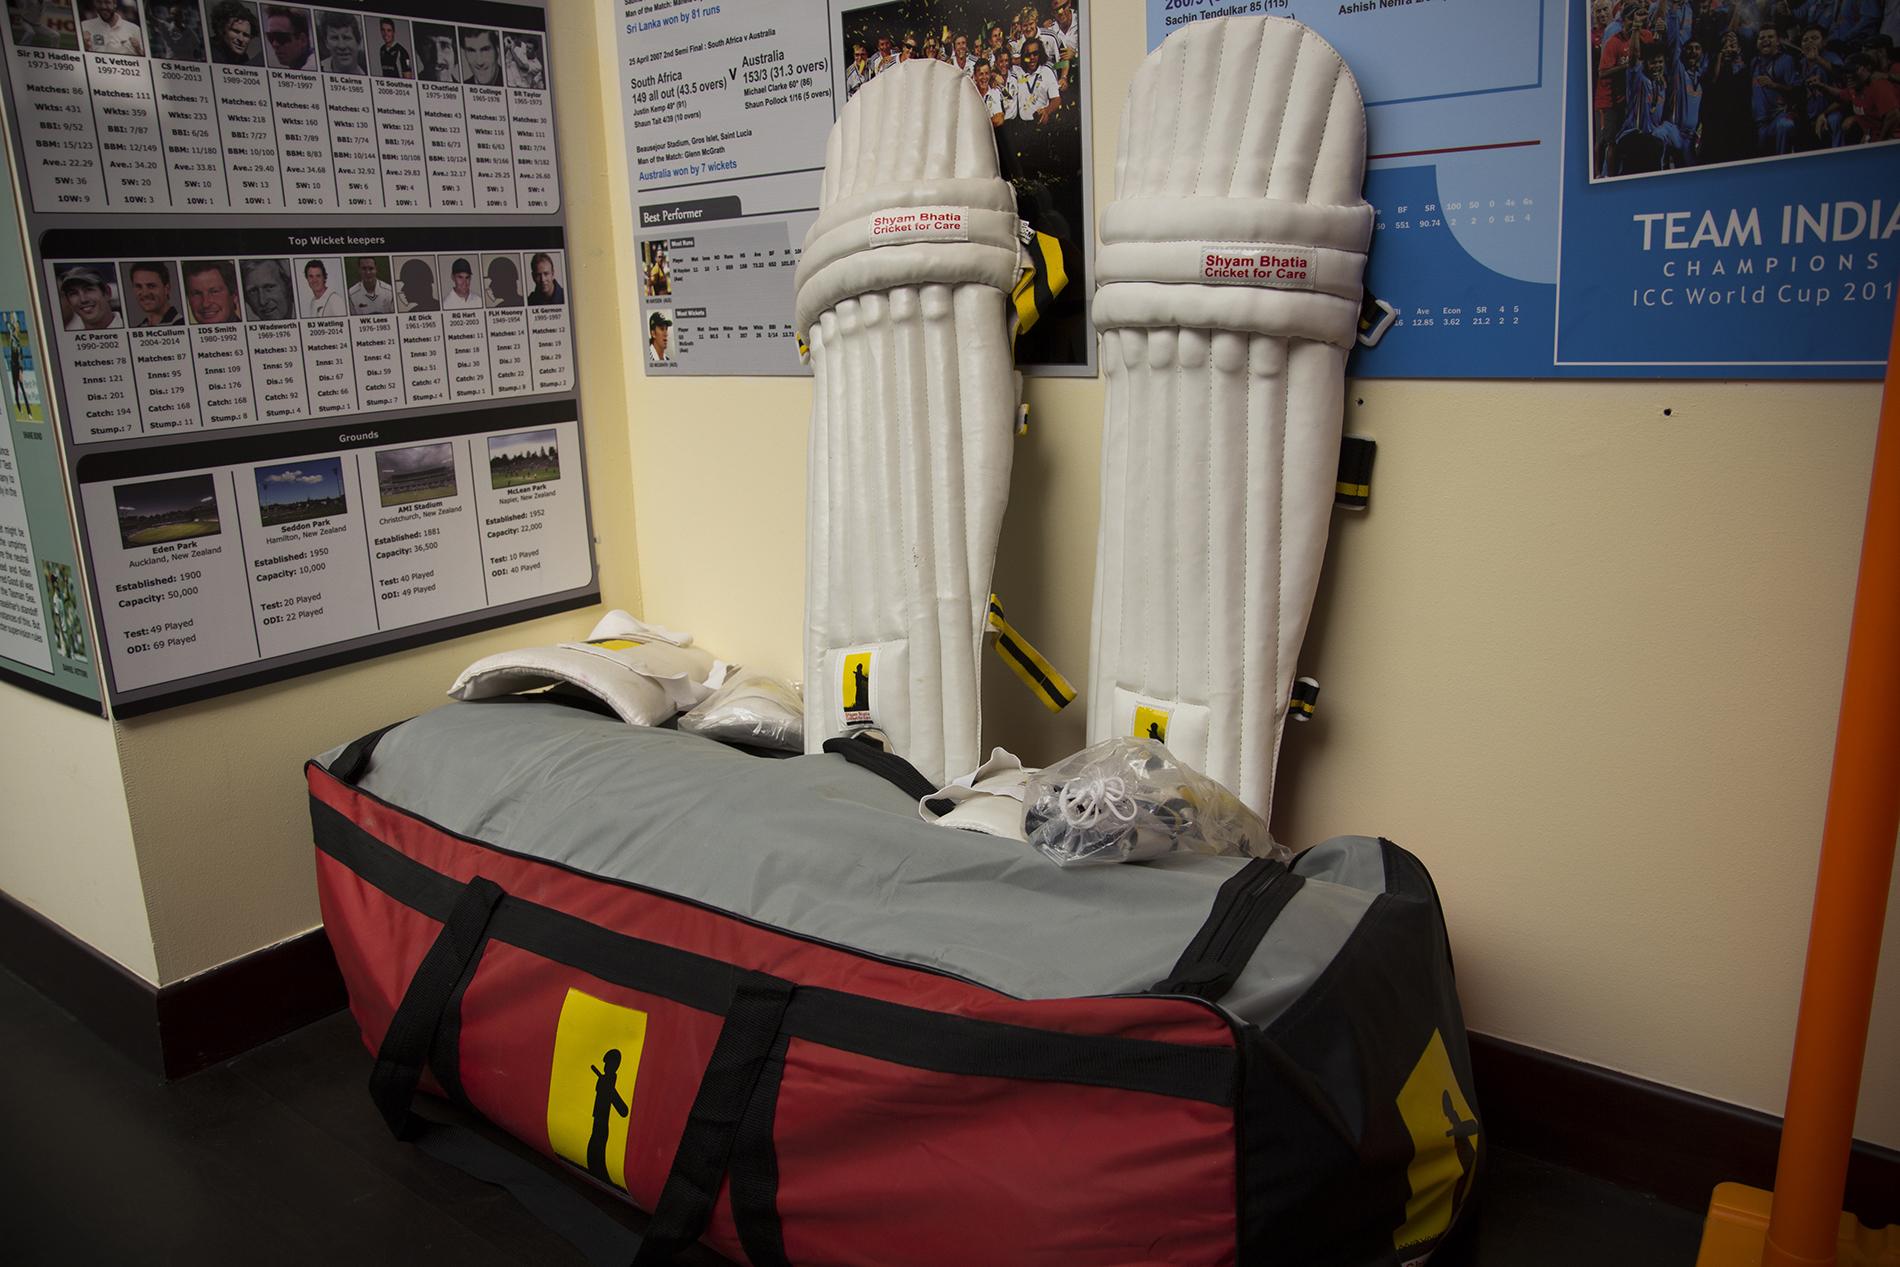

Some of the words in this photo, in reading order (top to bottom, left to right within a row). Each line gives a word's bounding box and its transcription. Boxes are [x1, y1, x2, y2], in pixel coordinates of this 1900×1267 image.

[1166, 14, 1197, 26] Sachin
[1200, 5, 1247, 19] Tendulkar
[1250, 1, 1262, 12] 85
[1265, 0, 1288, 11] (115)
[1339, 0, 1376, 15] Ashish
[627, 24, 638, 34] Sri
[639, 20, 661, 31] Lanka
[663, 16, 678, 25] won
[680, 13, 689, 23] by
[692, 8, 701, 19] 81
[703, 6, 720, 16] runs
[636, 55, 650, 64] April
[650, 52, 662, 61] 2007
[664, 50, 674, 59] 2nd
[674, 46, 689, 57] Semi
[690, 44, 704, 52] Final
[708, 40, 724, 49] South
[725, 36, 743, 45] Africa
[749, 29, 775, 40] Australia
[17, 49, 31, 58] Sir
[33, 51, 45, 60] RJ
[48, 52, 80, 62] Hadlee
[95, 56, 107, 65] DL
[109, 58, 139, 67] Vettori
[742, 50, 784, 67] Australia
[28, 61, 74, 71] 1973-1990
[98, 67, 140, 76] 1997-2012
[222, 67, 232, 75] CL
[234, 68, 258, 76] Cairns
[743, 69, 767, 83] 153/3
[770, 64, 793, 81] (31.3
[796, 58, 828, 74] overs)
[284, 73, 317, 81] Morrison
[631, 76, 655, 89] South
[658, 71, 682, 84] Africa
[729, 67, 737, 80] V
[223, 77, 261, 85] 1989-2004
[375, 79, 385, 87] TG
[385, 81, 412, 89] Southee
[26, 84, 70, 93] Matches:
[72, 87, 84, 95] 86
[378, 88, 410, 96] 2008-2014
[633, 92, 646, 103] 149
[649, 90, 659, 101] all
[661, 88, 674, 99] out
[677, 82, 697, 98] (43.5
[700, 77, 726, 92] overs)
[35, 104, 62, 112] Wkts:
[65, 105, 81, 113] 431
[650, 156, 655, 164] of
[665, 152, 683, 161] Match:
[684, 150, 701, 159] Glenn
[702, 146, 725, 155] McGrath
[639, 169, 671, 180] Australia
[673, 167, 689, 176] won
[690, 165, 700, 176] by
[701, 163, 706, 172] 7
[708, 160, 737, 171] wickets
[1397, 206, 1408, 214] BF
[1425, 204, 1436, 212] SR
[1446, 202, 1461, 210] 100
[1470, 200, 1480, 209] 50
[1489, 200, 1495, 209] 0
[644, 212, 660, 223] Best
[662, 208, 702, 220] Performer
[874, 215, 915, 226] Shyam
[920, 213, 961, 221] Bhatia
[1396, 221, 1410, 229] 551
[1419, 219, 1440, 228] 90.74
[1504, 215, 1515, 223] 61
[874, 224, 911, 235] Cricket
[934, 221, 961, 230] Care
[1634, 208, 1762, 250] TEAM
[288, 237, 307, 246] Top
[310, 236, 345, 245] Wicket
[347, 236, 385, 245] keepers
[1206, 255, 1254, 269] Shyam
[1260, 256, 1307, 268] Bhatia
[1664, 253, 1878, 277] CHAMPIONS
[1205, 268, 1249, 278] Cricket
[1253, 268, 1272, 278] for
[1276, 269, 1306, 279] Care
[1634, 289, 1673, 306] ICC
[1686, 286, 1764, 304] World
[1778, 285, 1830, 306] Cup
[1844, 282, 1891, 300] 201
[1443, 307, 1461, 315] Econ
[1476, 306, 1487, 314] SR
[1514, 305, 1519, 313] 5
[1413, 318, 1434, 326] 12.85
[1443, 318, 1460, 326] 3.62
[1473, 317, 1490, 325] 21.2
[132, 331, 144, 339] BB
[146, 329, 185, 337] McCullum
[214, 326, 237, 334] Smith
[77, 341, 118, 350] 1990-2002
[140, 338, 180, 347] 2004-2014
[74, 359, 114, 367] Matches:
[116, 357, 127, 365] 78
[150, 421, 182, 429] Stump.:
[339, 431, 378, 442] Grounds
[508, 486, 530, 494] McLean
[398, 505, 412, 513] AMI
[414, 500, 444, 512] Stadium
[280, 522, 308, 534] Seddon
[312, 519, 330, 527] Park
[266, 534, 300, 544] Hamilton,
[320, 525, 346, 535] Zealand
[152, 545, 175, 554] Eden
[177, 541, 197, 550] Park
[129, 555, 169, 568] Auckland,
[171, 553, 189, 561] New
[191, 546, 221, 557] Zealand
[116, 576, 176, 592] Established:
[180, 571, 201, 581] 1900
[118, 594, 164, 608] Capacity:
[168, 587, 198, 599] 50,000
[124, 629, 149, 638] Test:
[150, 625, 162, 633] 49
[165, 618, 193, 630] Played
[127, 644, 150, 654] ODI:
[154, 641, 164, 649] 69
[168, 634, 196, 646] Played
